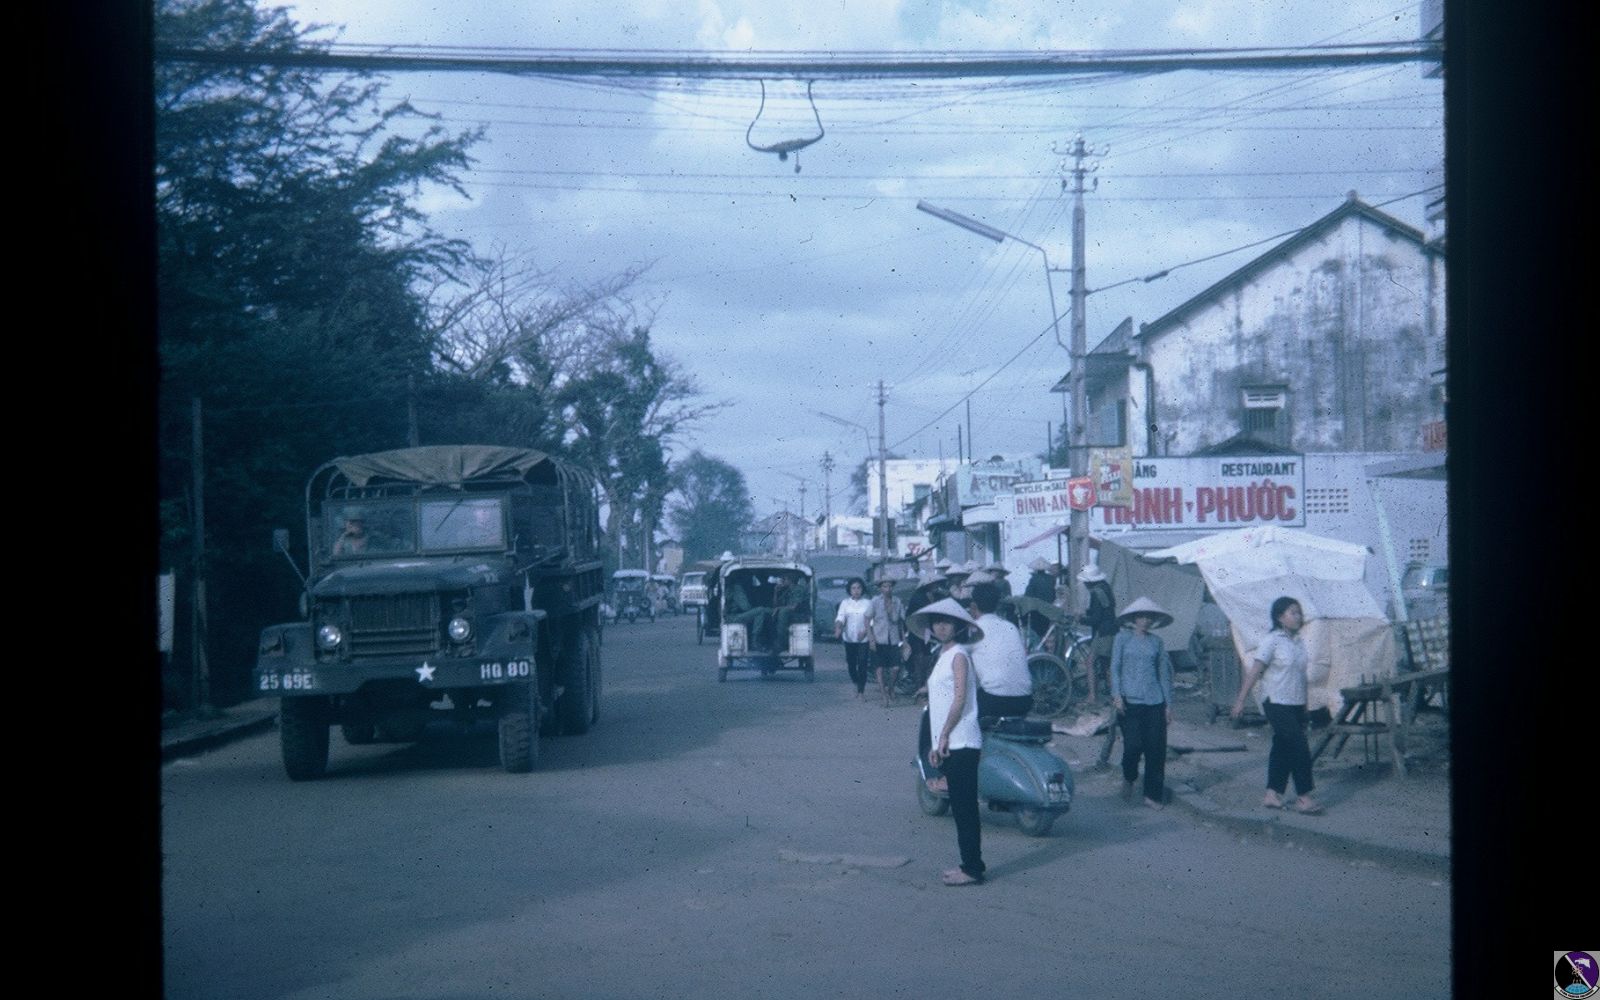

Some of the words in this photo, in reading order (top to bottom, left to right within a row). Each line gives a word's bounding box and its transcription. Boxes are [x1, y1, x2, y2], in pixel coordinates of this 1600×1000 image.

[1221, 462, 1296, 477] RESTAURANT
[1195, 478, 1296, 523] PHƯỚC
[480, 662, 502, 679] HQ
[260, 674, 279, 690] 25
